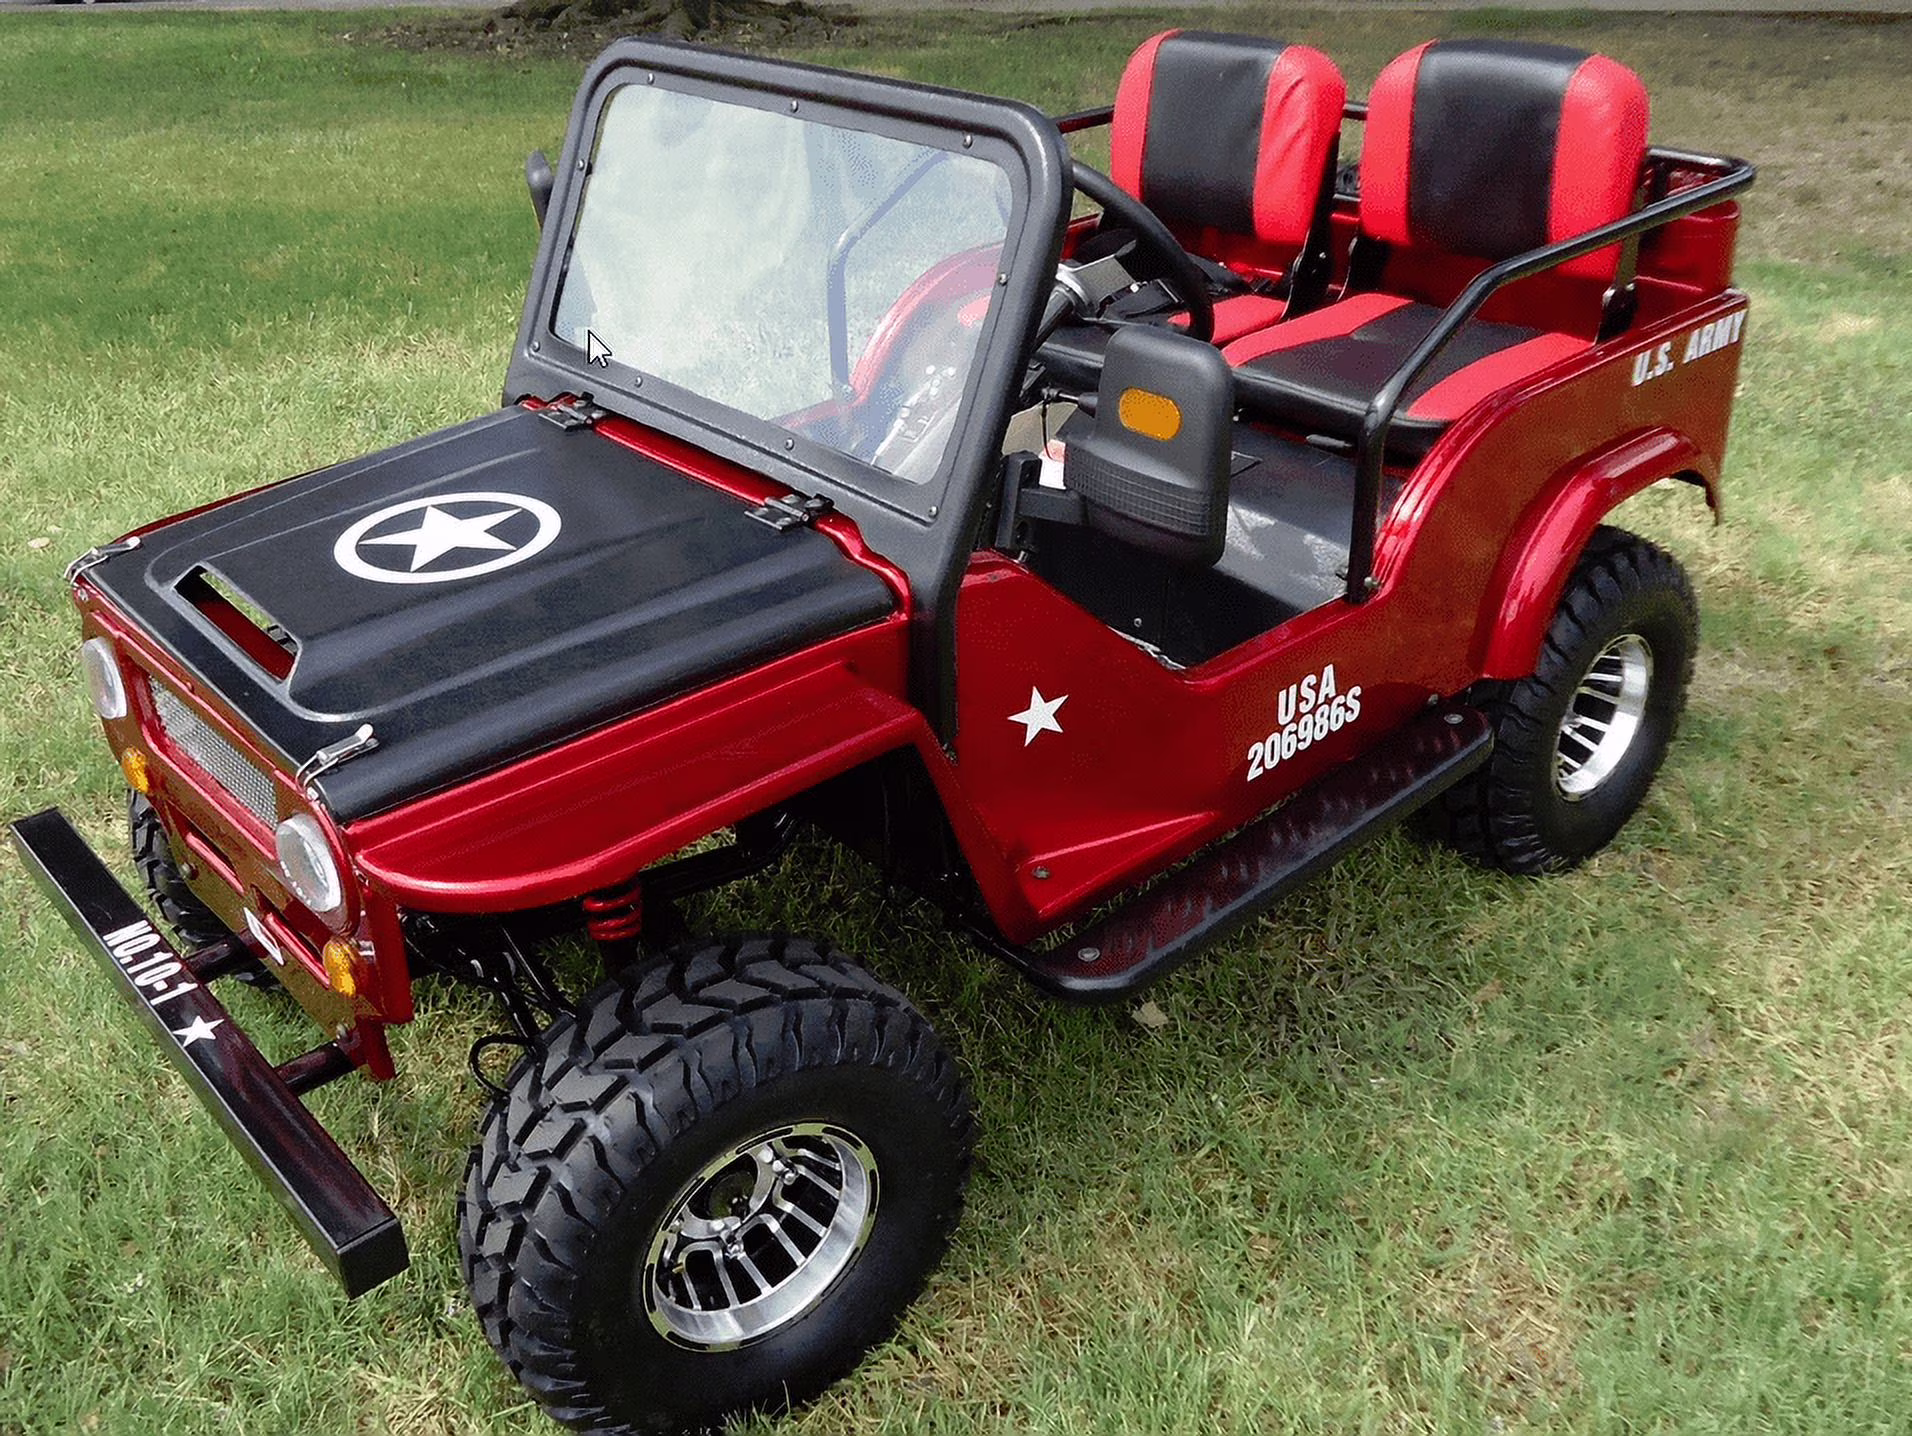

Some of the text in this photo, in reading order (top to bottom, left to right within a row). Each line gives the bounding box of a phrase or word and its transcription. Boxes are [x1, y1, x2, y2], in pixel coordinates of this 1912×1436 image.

[1632, 308, 1748, 387] U.S. ARMY
[1246, 685, 1362, 782] 206986S
[1278, 663, 1336, 726] USA
